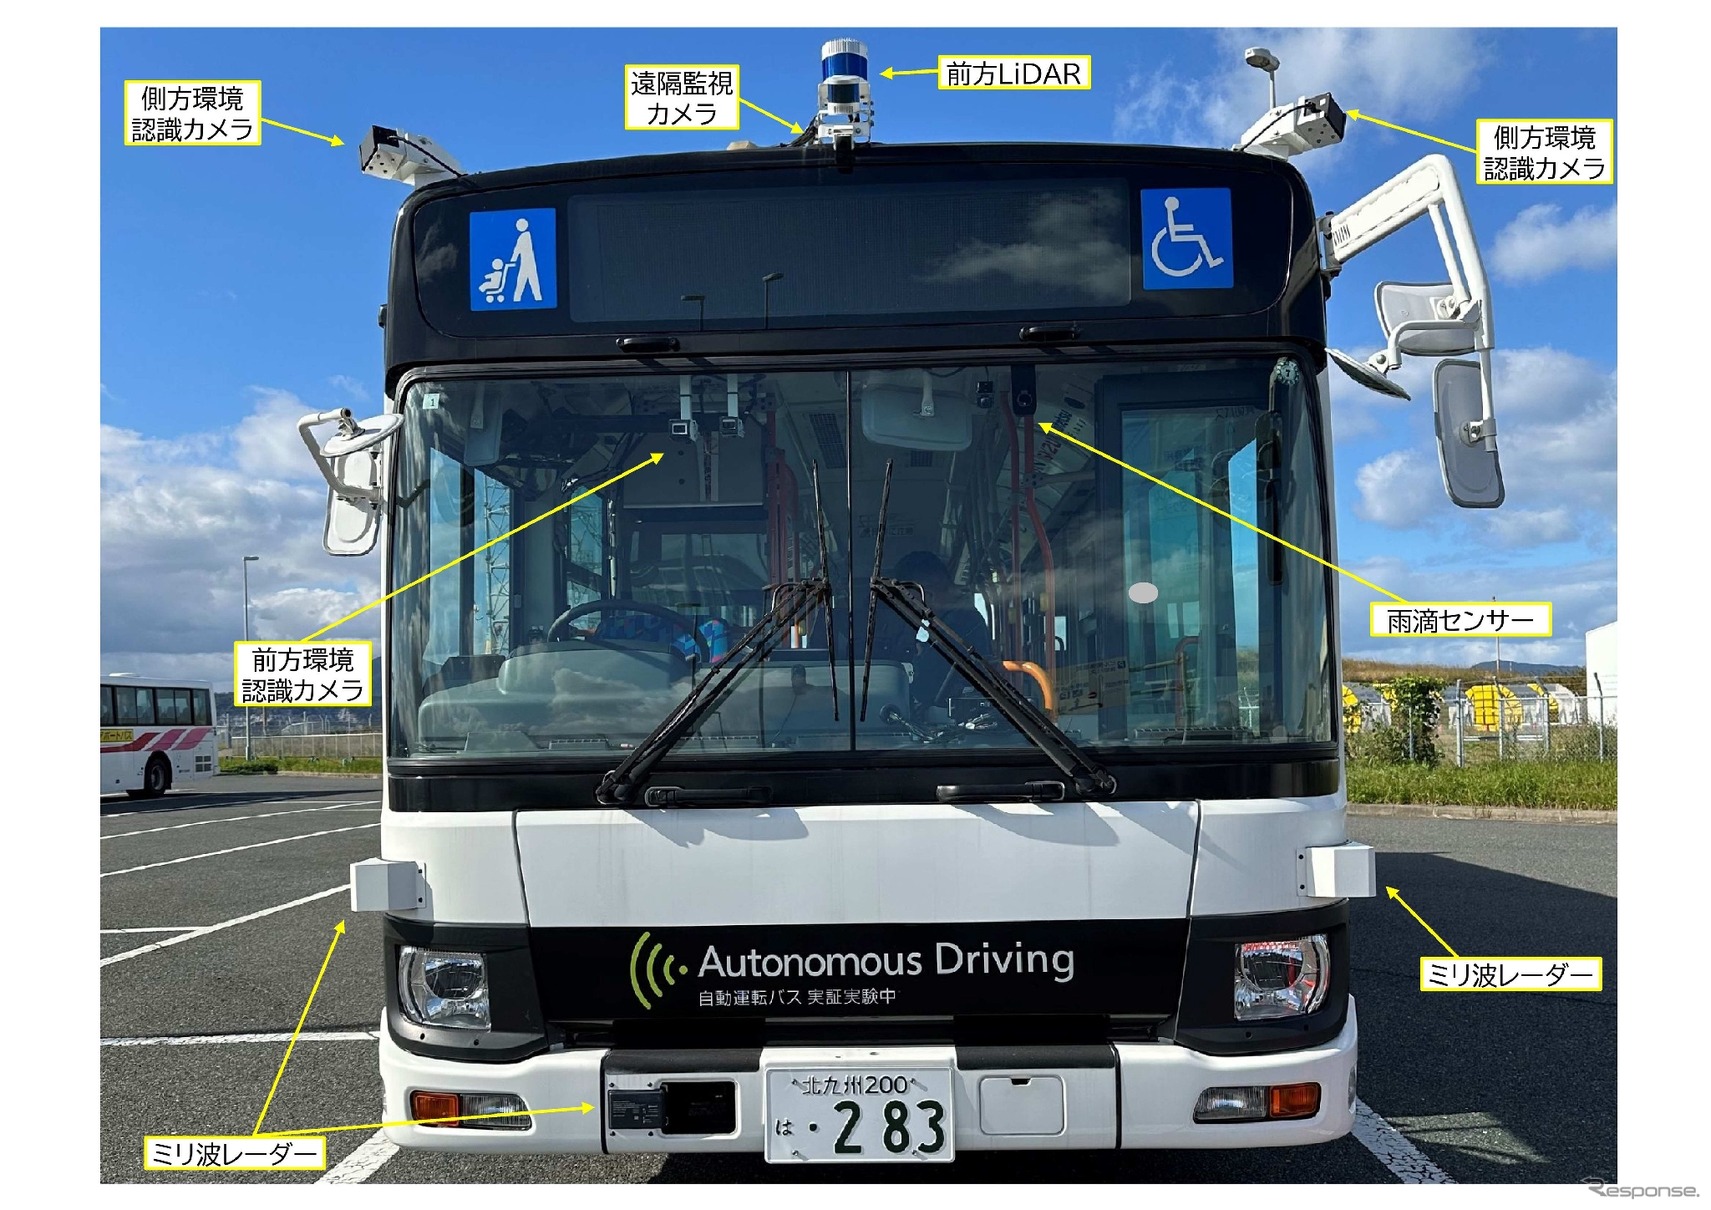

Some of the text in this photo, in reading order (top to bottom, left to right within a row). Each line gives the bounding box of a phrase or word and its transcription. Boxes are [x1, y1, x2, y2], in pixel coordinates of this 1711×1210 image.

[697, 941, 1075, 983] Autonomous Driving
[699, 987, 896, 1007] 自動運転バス 実証実験中
[775, 1119, 793, 1136] は
